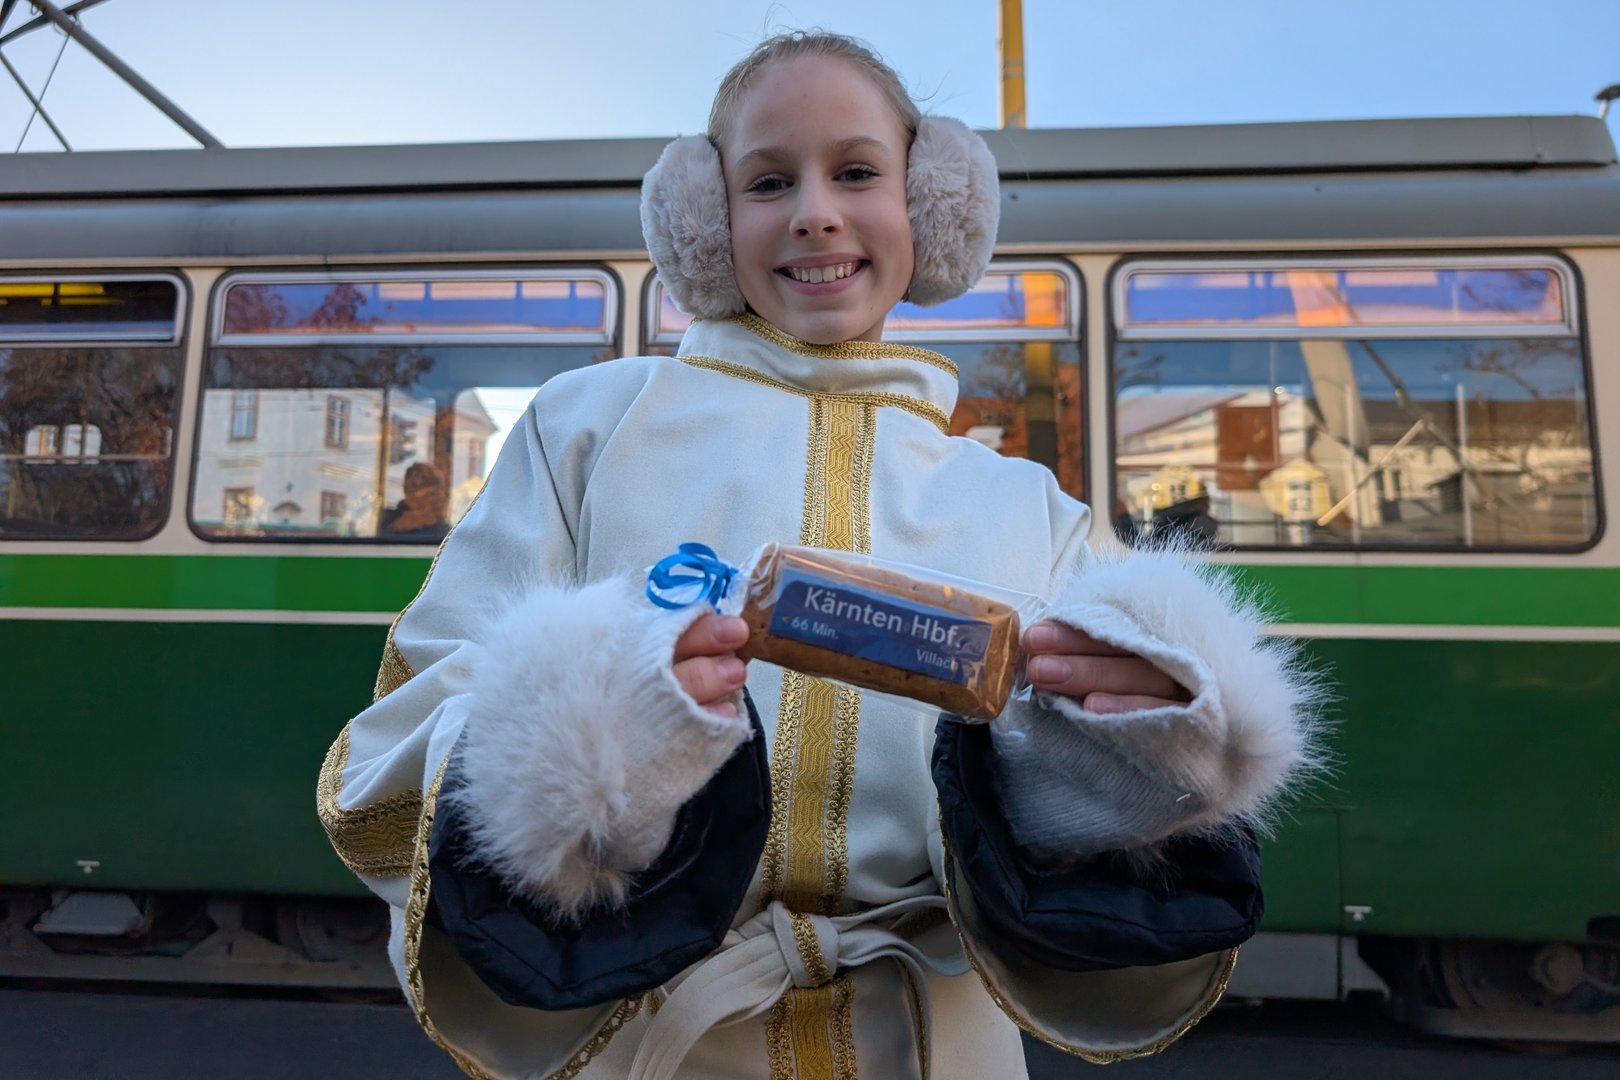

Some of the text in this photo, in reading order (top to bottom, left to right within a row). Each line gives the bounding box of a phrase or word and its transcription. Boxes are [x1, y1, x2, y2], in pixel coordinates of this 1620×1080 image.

[792, 616, 839, 640] 66 Min.
[804, 586, 961, 648] Kärnten Hbf.
